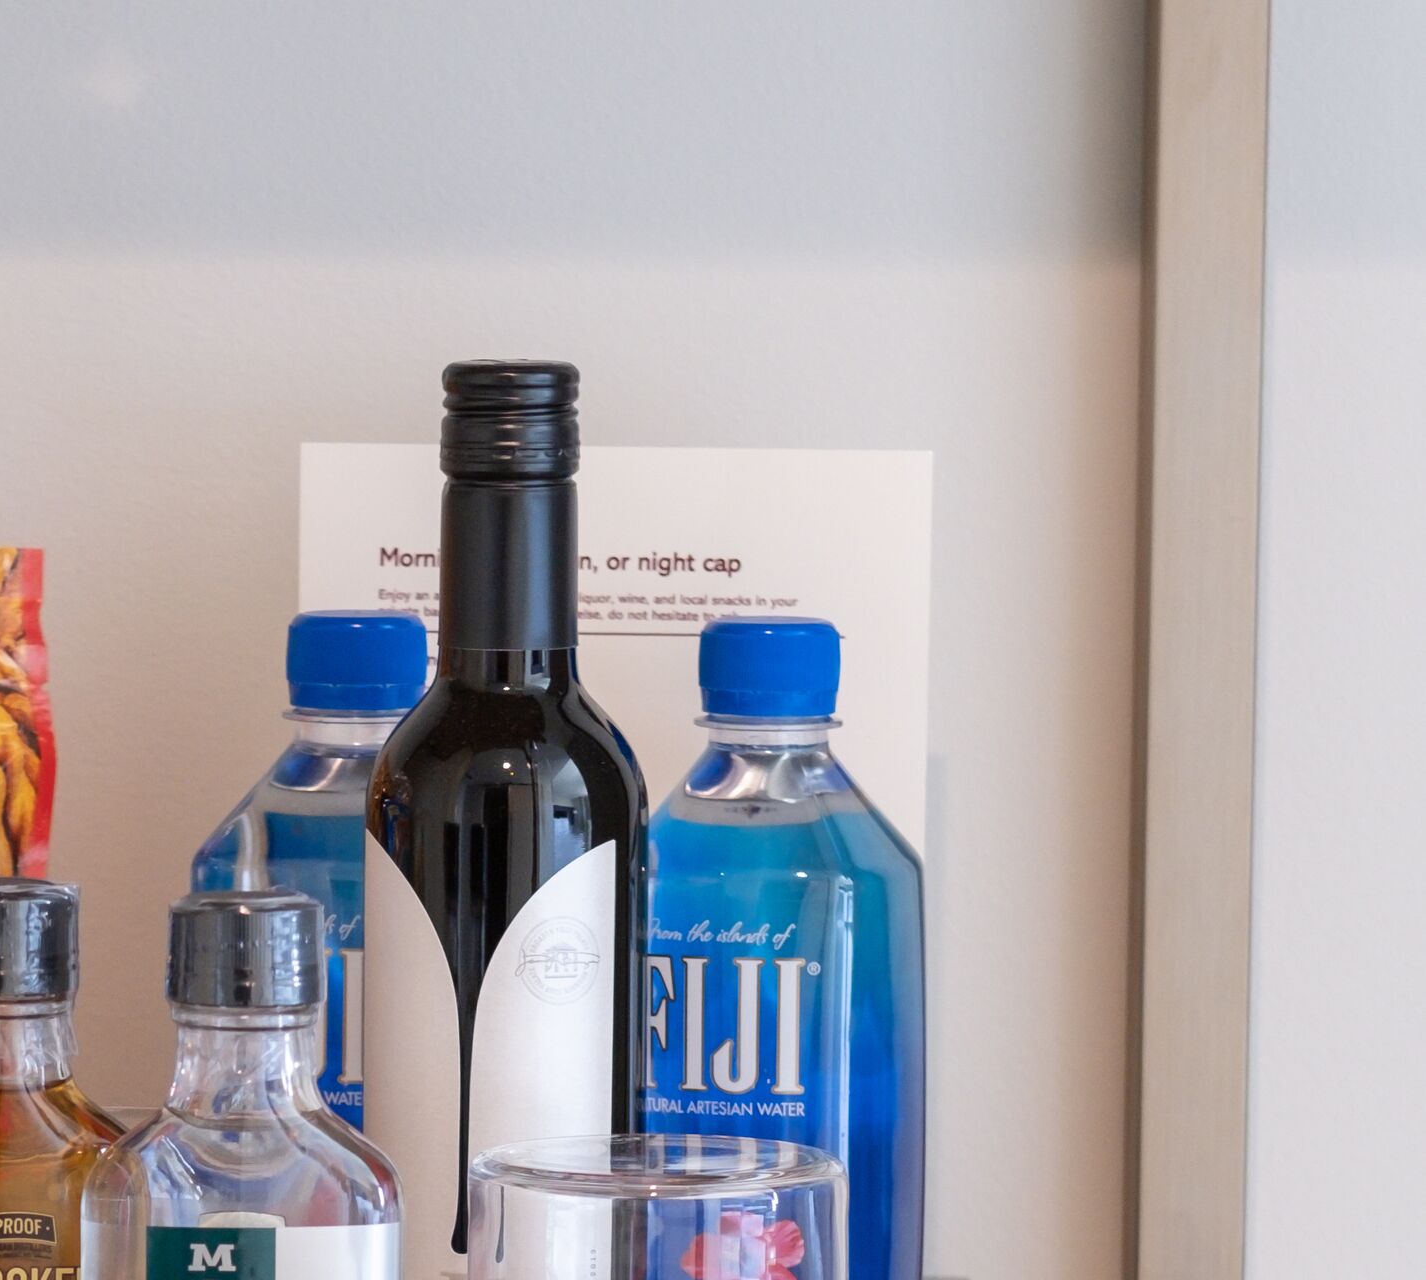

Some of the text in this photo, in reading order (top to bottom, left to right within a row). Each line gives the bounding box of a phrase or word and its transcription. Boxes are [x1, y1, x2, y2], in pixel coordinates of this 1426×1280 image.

[378, 547, 440, 568] Morni
[606, 555, 630, 571] or
[638, 551, 695, 576] night
[702, 556, 742, 577] cap
[378, 588, 411, 604] Enjoy
[617, 593, 650, 606] wine,
[653, 593, 675, 606] and
[679, 593, 706, 606] local
[711, 594, 752, 607] snacks
[756, 594, 767, 607] in
[770, 597, 798, 609] your
[607, 610, 624, 621] do
[627, 611, 647, 621] not
[651, 610, 699, 622] hesitate
[338, 914, 362, 941] of
[686, 919, 714, 943] the
[716, 920, 770, 946] islands
[771, 922, 797, 950] of
[641, 953, 806, 1096] FIJI
[323, 1090, 363, 1107] WATE
[638, 1096, 806, 1118] TURAL ARTESIAN WATER
